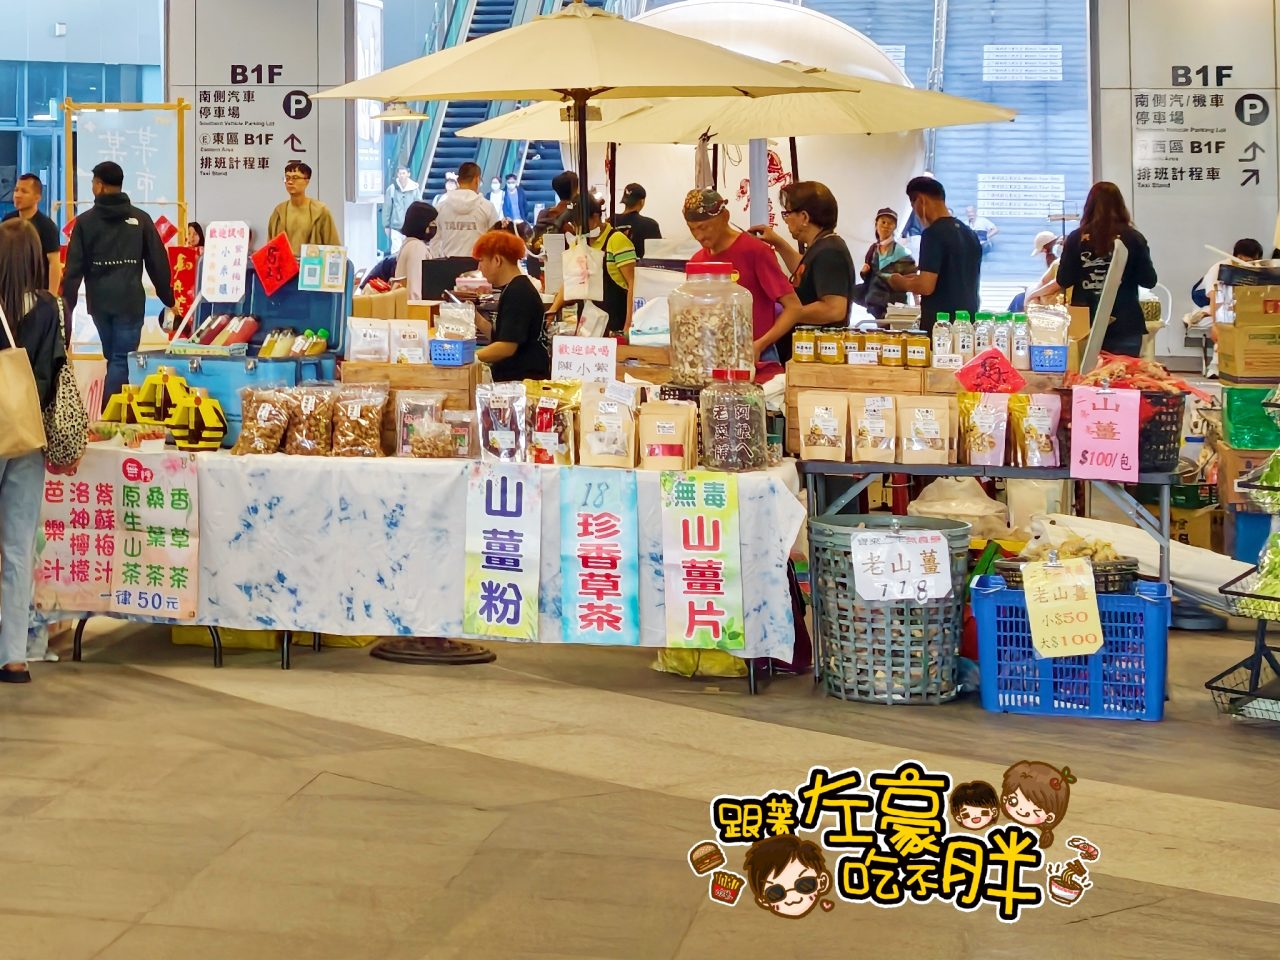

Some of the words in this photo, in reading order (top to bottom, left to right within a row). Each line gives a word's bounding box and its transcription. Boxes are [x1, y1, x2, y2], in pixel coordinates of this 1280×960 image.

[231, 64, 283, 84] B1F
[1172, 65, 1233, 87] B1F
[200, 90, 255, 103] 南側汽車
[200, 106, 240, 119] 停車場
[1136, 111, 1184, 125] 停車場
[244, 133, 274, 145] B1F
[1190, 141, 1226, 154] B1F
[200, 157, 270, 170] 排班計程車
[1137, 167, 1221, 181] 排班計程車
[558, 344, 609, 357] 歡迎試喝
[1090, 397, 1120, 441] 山薑
[674, 481, 726, 507] 無毒
[44, 480, 65, 582] 芭樂汁
[70, 481, 90, 583] 洛神檸檬
[94, 482, 115, 584] 紫蘇梅汁
[122, 485, 142, 586] 原生山茶
[146, 486, 166, 587] 桑葉茶
[170, 488, 190, 589] 香草茶
[478, 476, 523, 625] 山薑粉
[861, 548, 941, 576] 老山薑
[576, 512, 623, 632] 珍香草茶
[681, 515, 725, 639] 山薑片
[1033, 584, 1088, 603] 老山薑
